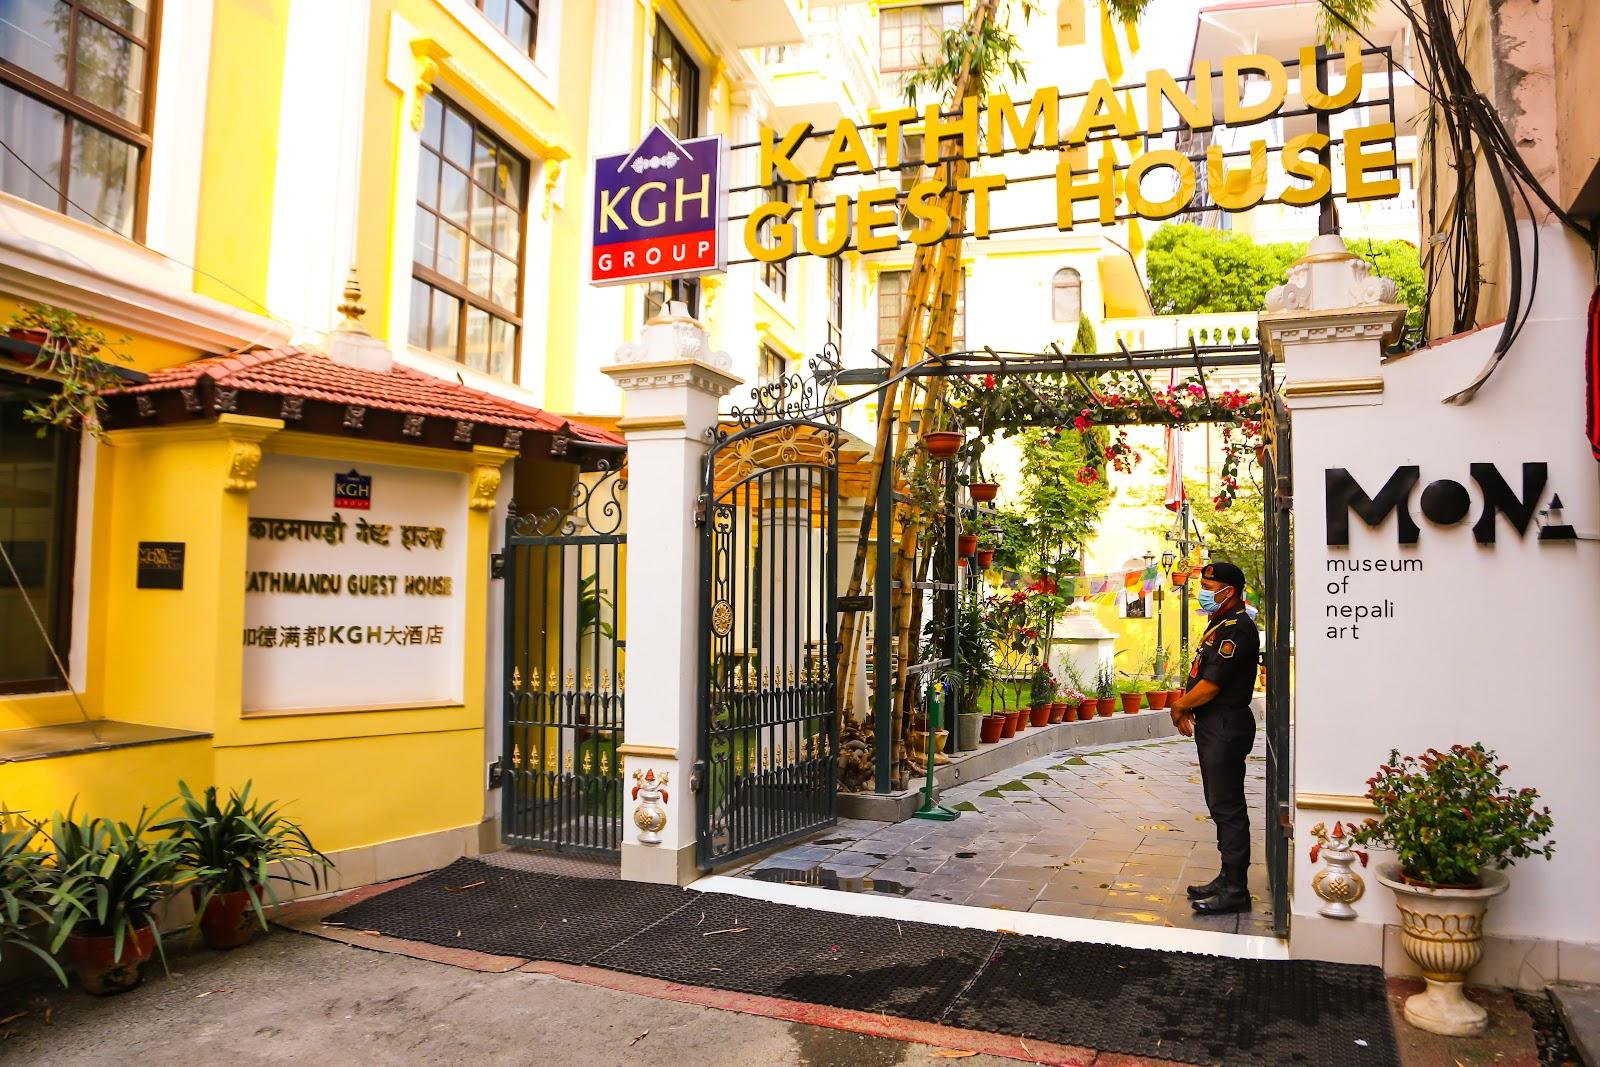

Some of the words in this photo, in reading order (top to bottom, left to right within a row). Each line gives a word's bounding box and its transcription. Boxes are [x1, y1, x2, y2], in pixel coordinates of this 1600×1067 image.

[760, 40, 1363, 189] KATHMANDU
[599, 173, 710, 234] KGH
[743, 174, 1007, 263] GUEST
[1056, 122, 1401, 233] HOUSE
[598, 241, 710, 271] GROUP
[336, 483, 370, 497] KGH
[1326, 558, 1423, 572] museum
[347, 575, 398, 595] GUEST
[404, 576, 452, 596] HOUSE
[1326, 575, 1350, 595] of
[1326, 599, 1394, 622] nepali
[1326, 624, 1359, 640] art
